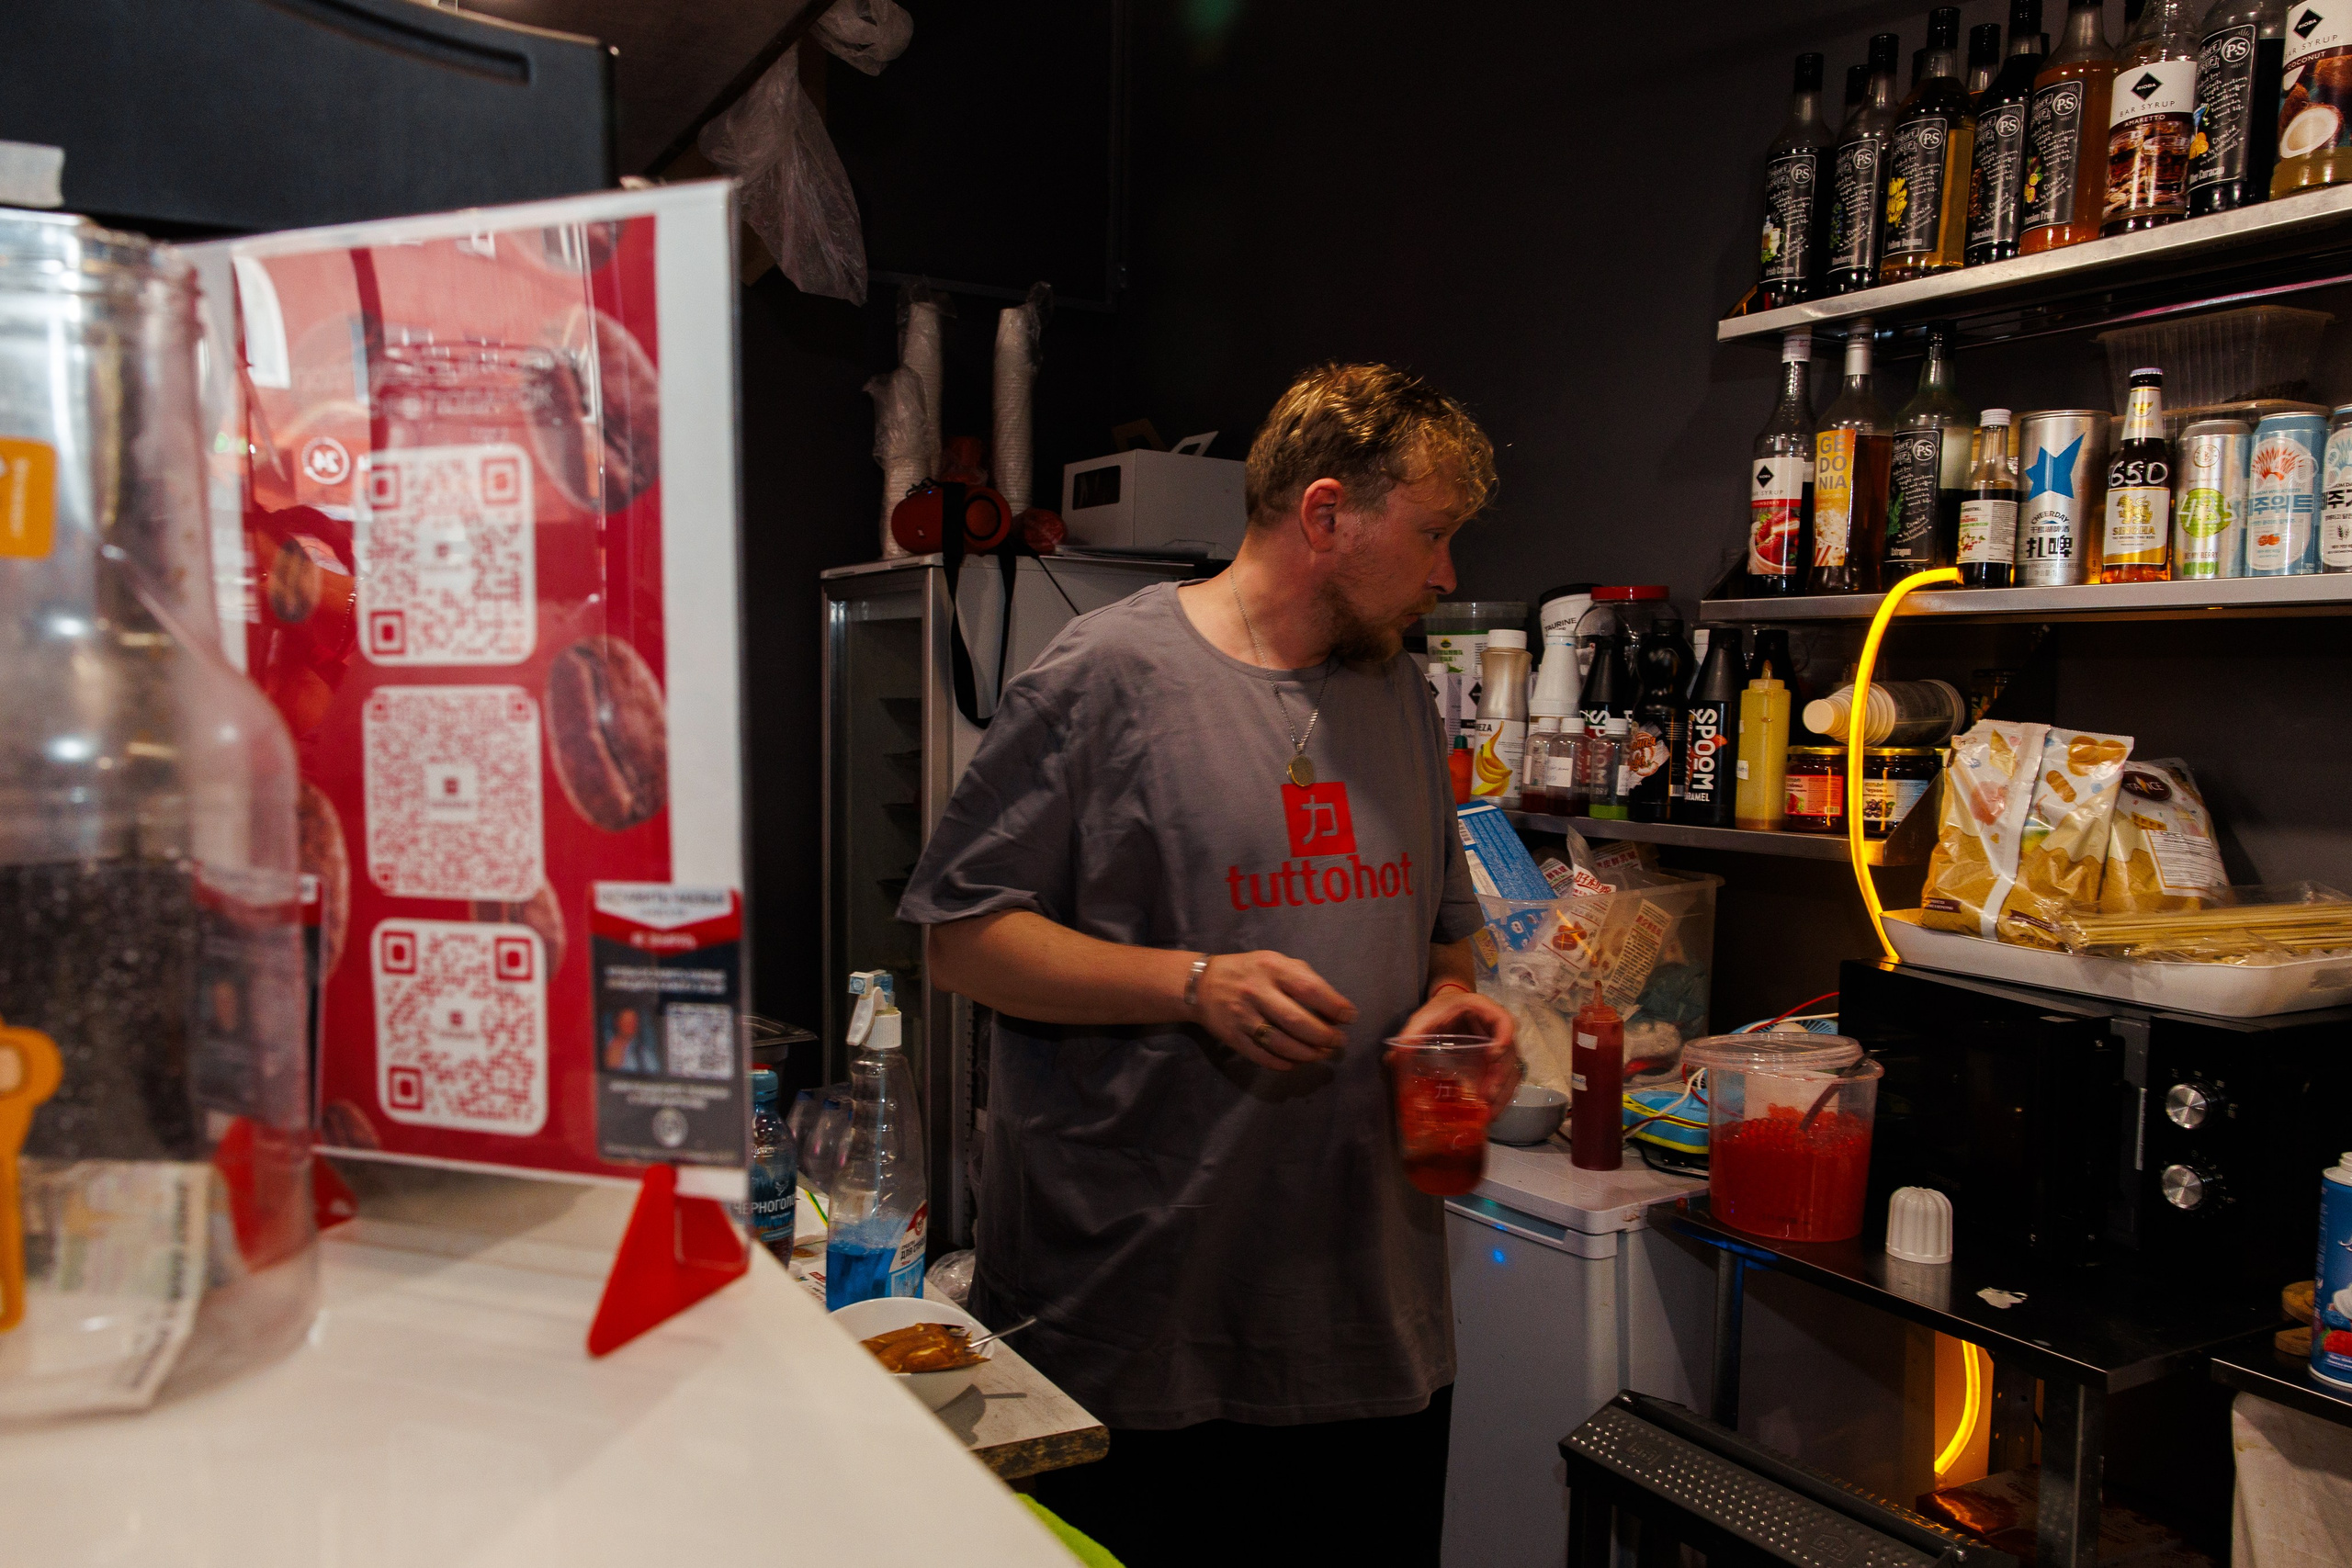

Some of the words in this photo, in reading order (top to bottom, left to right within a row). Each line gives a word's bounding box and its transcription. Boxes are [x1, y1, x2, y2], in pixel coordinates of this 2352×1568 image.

[2298, 19, 2317, 29] RIOBA
[2301, 34, 2338, 51] SYRUP
[2288, 51, 2326, 70] COCONUT
[2120, 107, 2136, 118] BAR
[2141, 100, 2176, 110] SYRUP
[2124, 114, 2165, 127] AMARETTO
[1820, 434, 1846, 455] GE
[1820, 455, 1847, 473] DO
[1819, 474, 1848, 491] NIA
[2110, 461, 2168, 487] 650
[2030, 511, 2070, 525] CHEERDAY
[2112, 525, 2156, 536] SINGHA
[2026, 535, 2073, 558] 扎啤
[1544, 617, 1577, 632] TAURINE
[1692, 708, 1718, 790] SPOOM
[1226, 852, 1414, 911] tuttohot
